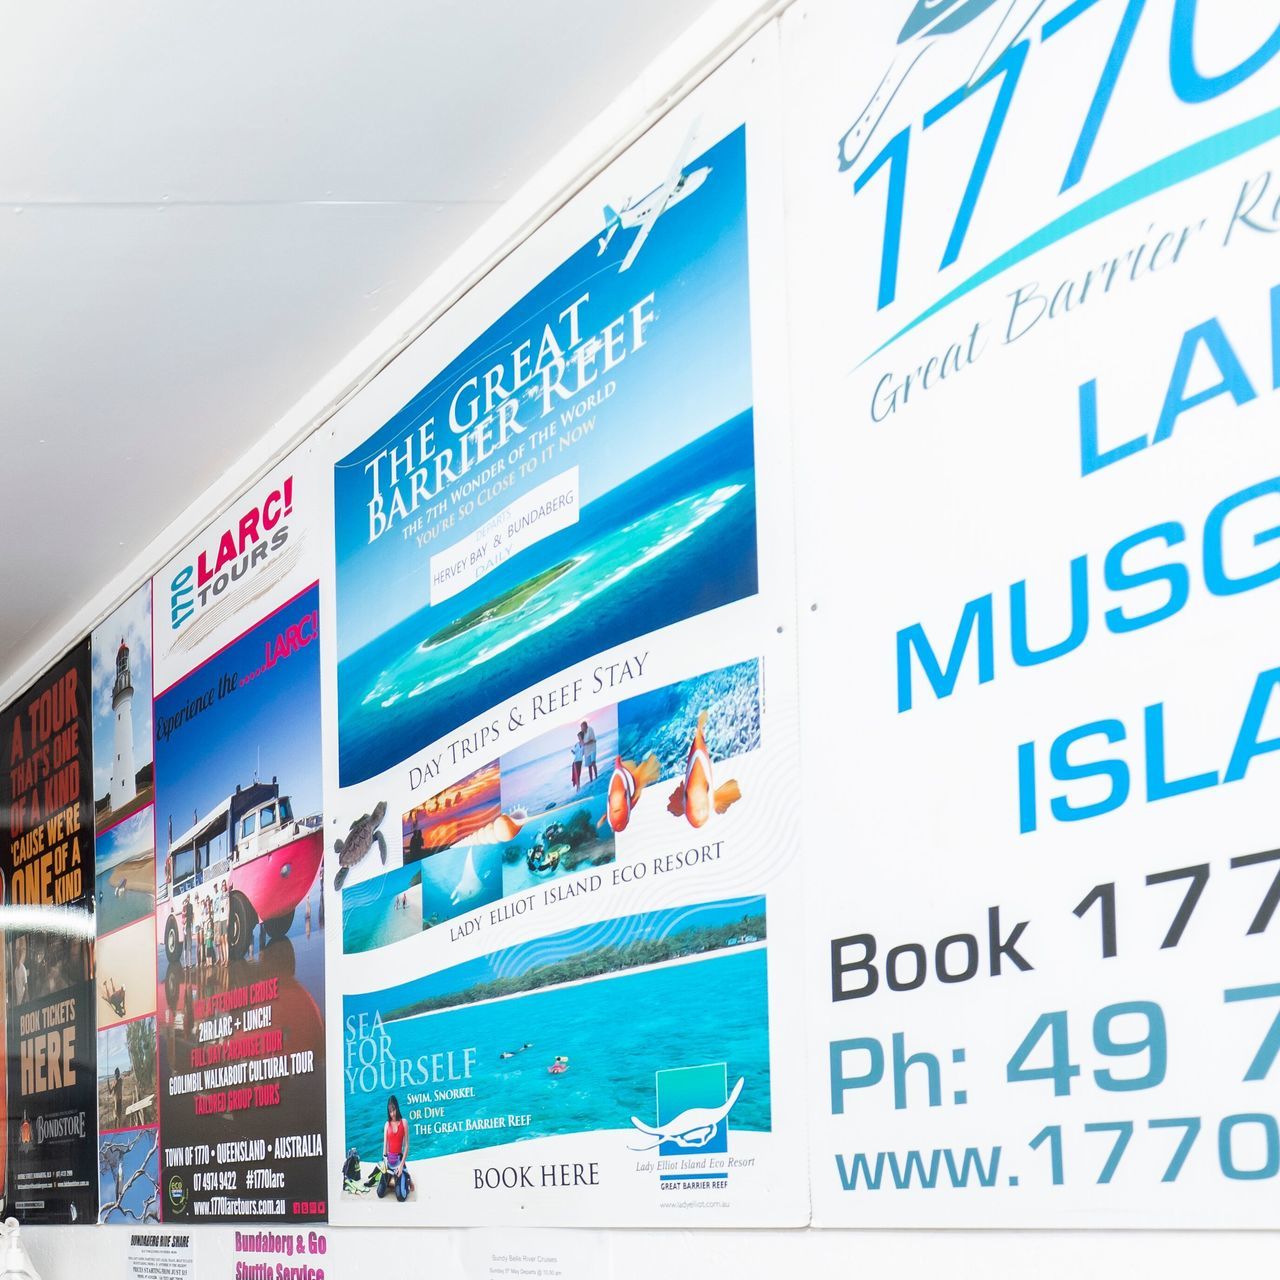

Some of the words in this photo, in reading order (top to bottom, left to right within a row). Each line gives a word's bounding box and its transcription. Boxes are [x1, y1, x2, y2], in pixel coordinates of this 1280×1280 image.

[870, 315, 987, 423] Great
[1001, 216, 1207, 346] Barrier
[364, 415, 437, 500] THE
[448, 292, 591, 436] GREAT
[368, 396, 528, 545] BARRIER
[539, 292, 657, 421] REEF
[402, 518, 424, 541] THE
[426, 501, 448, 523] 7TH
[450, 459, 506, 502] WONDER
[508, 445, 526, 464] OF
[529, 422, 557, 451] THE
[560, 380, 617, 428] WORLD
[476, 475, 516, 507] CLOSE
[519, 460, 537, 478] TO
[558, 415, 597, 450] NOW
[171, 565, 195, 631] 1770
[196, 475, 294, 589] LARC!
[432, 553, 469, 588] HERVEY
[470, 542, 490, 567] BAY
[507, 488, 575, 538] BUNDABERG
[197, 525, 289, 608] TOURS
[10, 714, 24, 767] A
[28, 667, 79, 749] TOUR
[155, 686, 215, 743] Experience
[217, 670, 239, 701] the
[407, 752, 445, 793] DAY
[445, 721, 501, 777] TRIPS
[507, 705, 525, 731] &
[531, 674, 584, 720] REEF
[592, 650, 651, 694] STAY
[10, 748, 50, 800] THAT'S
[53, 720, 80, 766] ONE
[10, 797, 27, 839] OF
[44, 759, 80, 819] KIND
[46, 801, 81, 848] WE'RE
[10, 850, 53, 907] ONE
[54, 841, 69, 876] OF
[54, 866, 82, 907] KIND
[449, 913, 484, 943] LADY
[489, 894, 537, 928] ELLIOT
[542, 873, 603, 910] ISLAND
[612, 860, 648, 887] ECO
[652, 840, 726, 877] RESORT
[830, 905, 1035, 1003] Book
[249, 977, 280, 1006] CRUISE
[20, 1011, 41, 1037] BOOK
[41, 998, 76, 1027] TICKETS
[215, 1017, 234, 1040] LARC
[242, 1005, 273, 1028] LUNCH!
[345, 1009, 387, 1043] SEA
[20, 1025, 78, 1097] HERE
[204, 1063, 248, 1091] WALKABOUT
[248, 1056, 289, 1082] CULTURAL
[290, 1050, 315, 1075] TOUR
[345, 1047, 477, 1095] YOURSELF
[346, 1034, 397, 1069] FOR
[828, 1031, 968, 1116] Ph:
[1005, 1000, 1169, 1098] 49
[193, 1092, 227, 1116] TAILORED
[227, 1088, 253, 1112] GROUP
[253, 1083, 281, 1107] TOURS
[424, 1106, 446, 1119] DIVE
[434, 1086, 476, 1102] SNORKEL
[36, 1111, 87, 1144] BONDSTORE
[414, 1122, 433, 1135] THE
[433, 1120, 464, 1134] GREAT
[465, 1117, 506, 1131] BARRIER
[507, 1114, 532, 1128] REEF
[165, 1146, 184, 1168] TOWN
[184, 1145, 194, 1167] OF
[194, 1144, 210, 1166] 1770
[216, 1138, 266, 1165] QUEENSLAND
[274, 1133, 323, 1160] AUSTRALIA
[635, 1161, 655, 1174] Lady
[656, 1159, 679, 1171] Elliot
[680, 1158, 707, 1170] Island
[709, 1157, 725, 1169] Eco
[727, 1156, 756, 1168] Resort
[202, 1171, 219, 1191] 4974
[219, 1170, 237, 1190] 9422
[245, 1169, 286, 1190] #1770larc
[472, 1165, 535, 1190] BOOK
[539, 1161, 600, 1188] HERE
[660, 1181, 681, 1191] GREAT
[682, 1180, 711, 1190] BARRIER
[711, 1180, 729, 1189] REEF
[193, 1196, 287, 1216] www.1770larctours.com.au
[172, 1235, 190, 1249] SHARE
[234, 1231, 293, 1256] Bundaberg
[296, 1234, 306, 1254] &
[307, 1231, 327, 1255] Go
